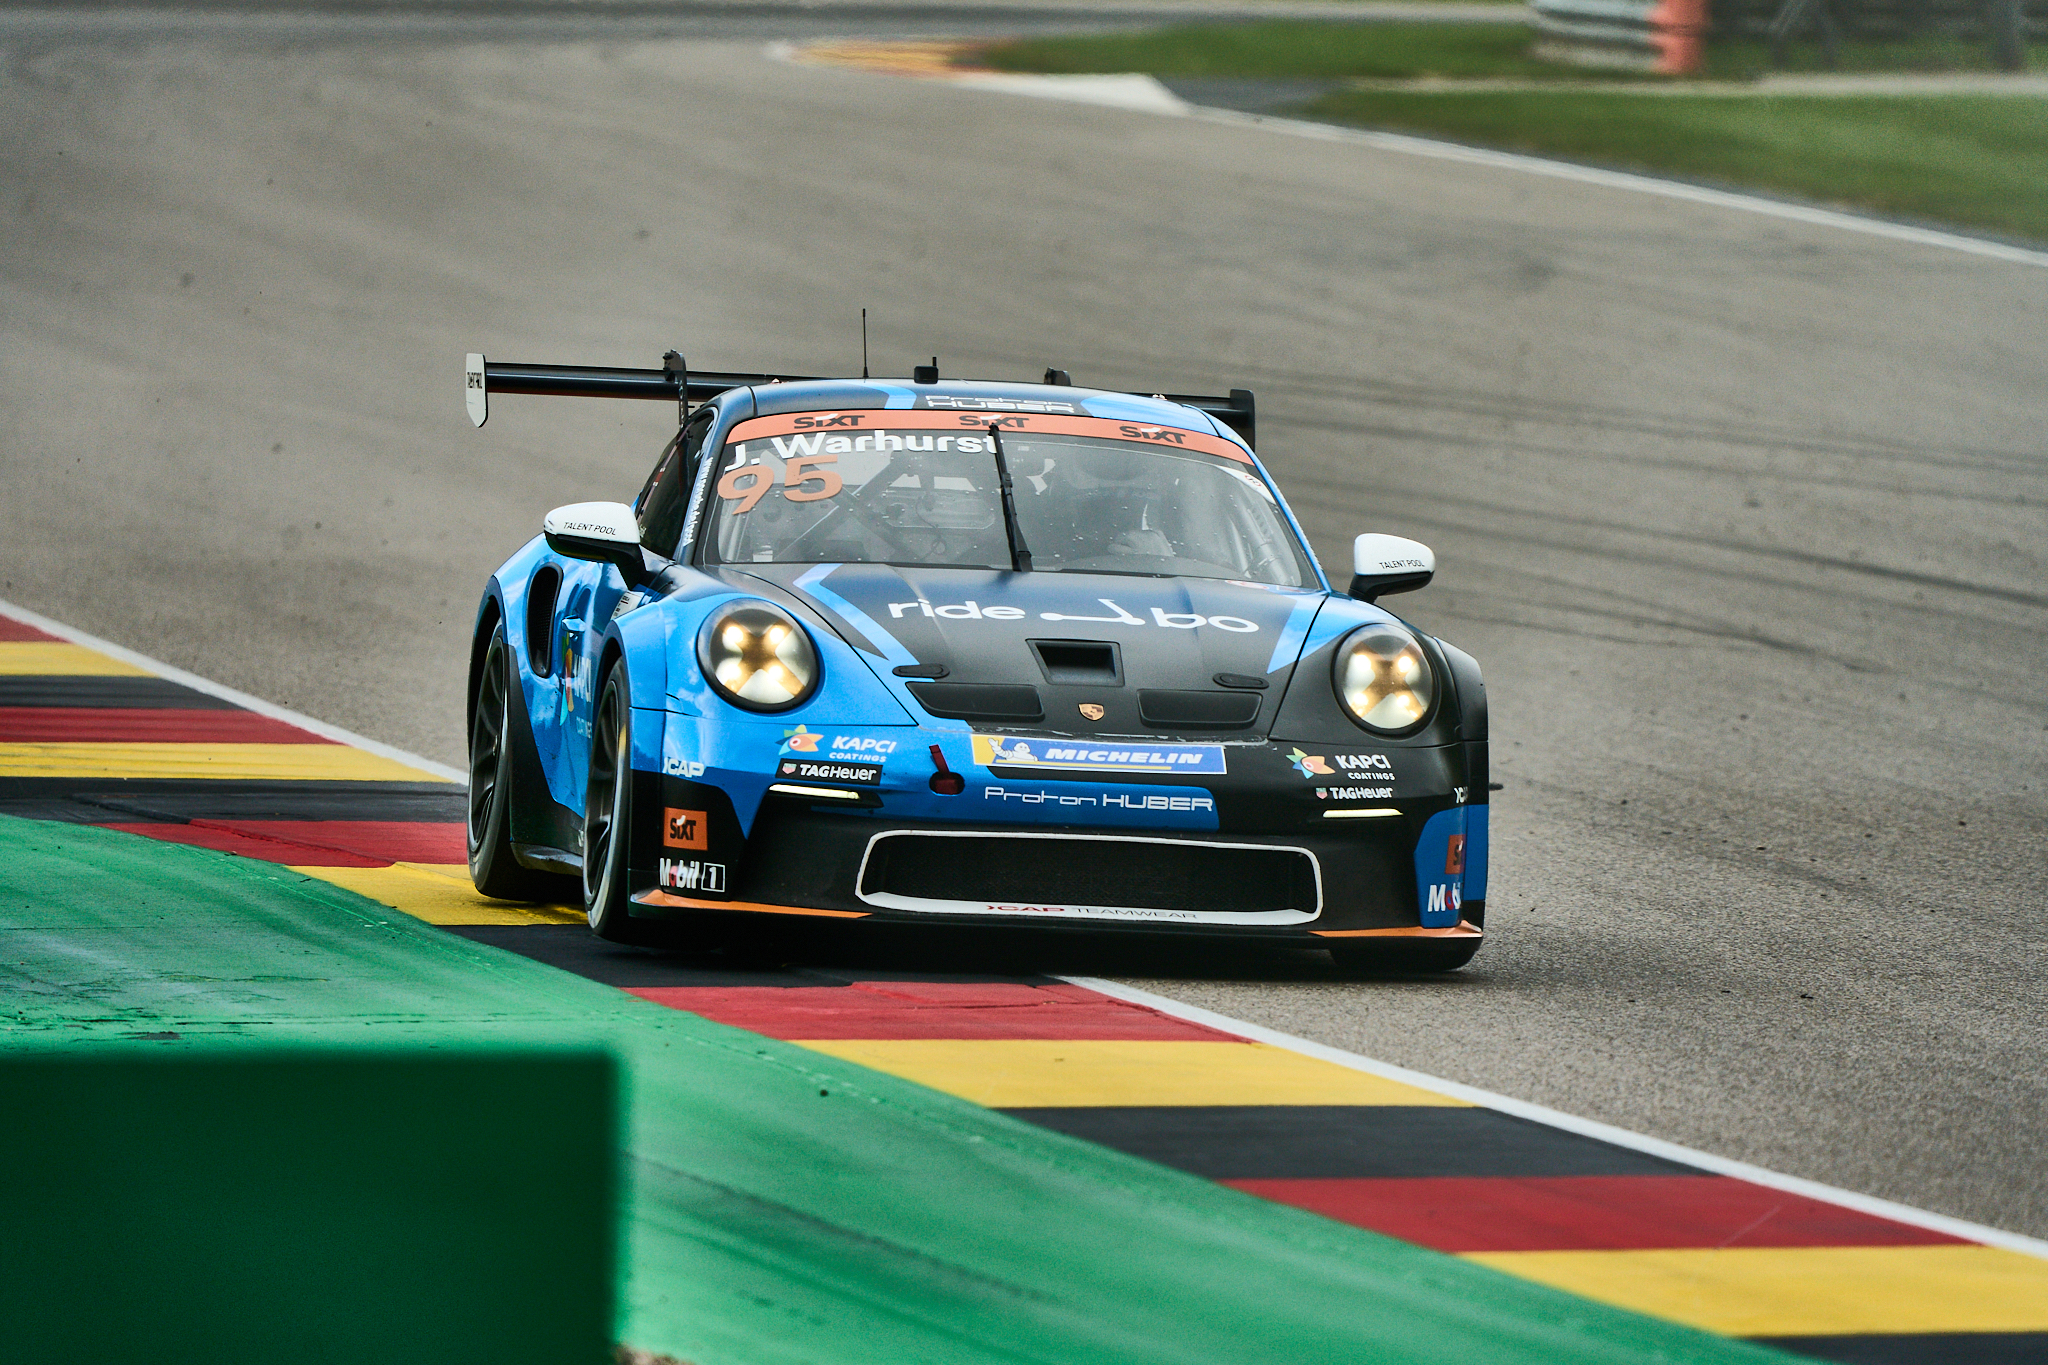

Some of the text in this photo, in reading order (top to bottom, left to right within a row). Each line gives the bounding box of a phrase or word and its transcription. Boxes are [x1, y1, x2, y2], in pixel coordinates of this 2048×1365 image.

[724, 430, 1003, 472] J. Warhurst
[717, 455, 843, 516] 95
[563, 521, 617, 536] TALENT POOL
[1379, 559, 1425, 570] TALENT POOL
[887, 598, 1260, 633] ride bo
[831, 736, 897, 754] KAPCI
[829, 752, 888, 763] COATINGS
[1044, 748, 1204, 765] MICHELIN
[1334, 754, 1392, 769] KAPCI
[1347, 771, 1396, 781] COATINGS
[984, 786, 1213, 812] Proton HUBER
[659, 857, 700, 889] Mobil
